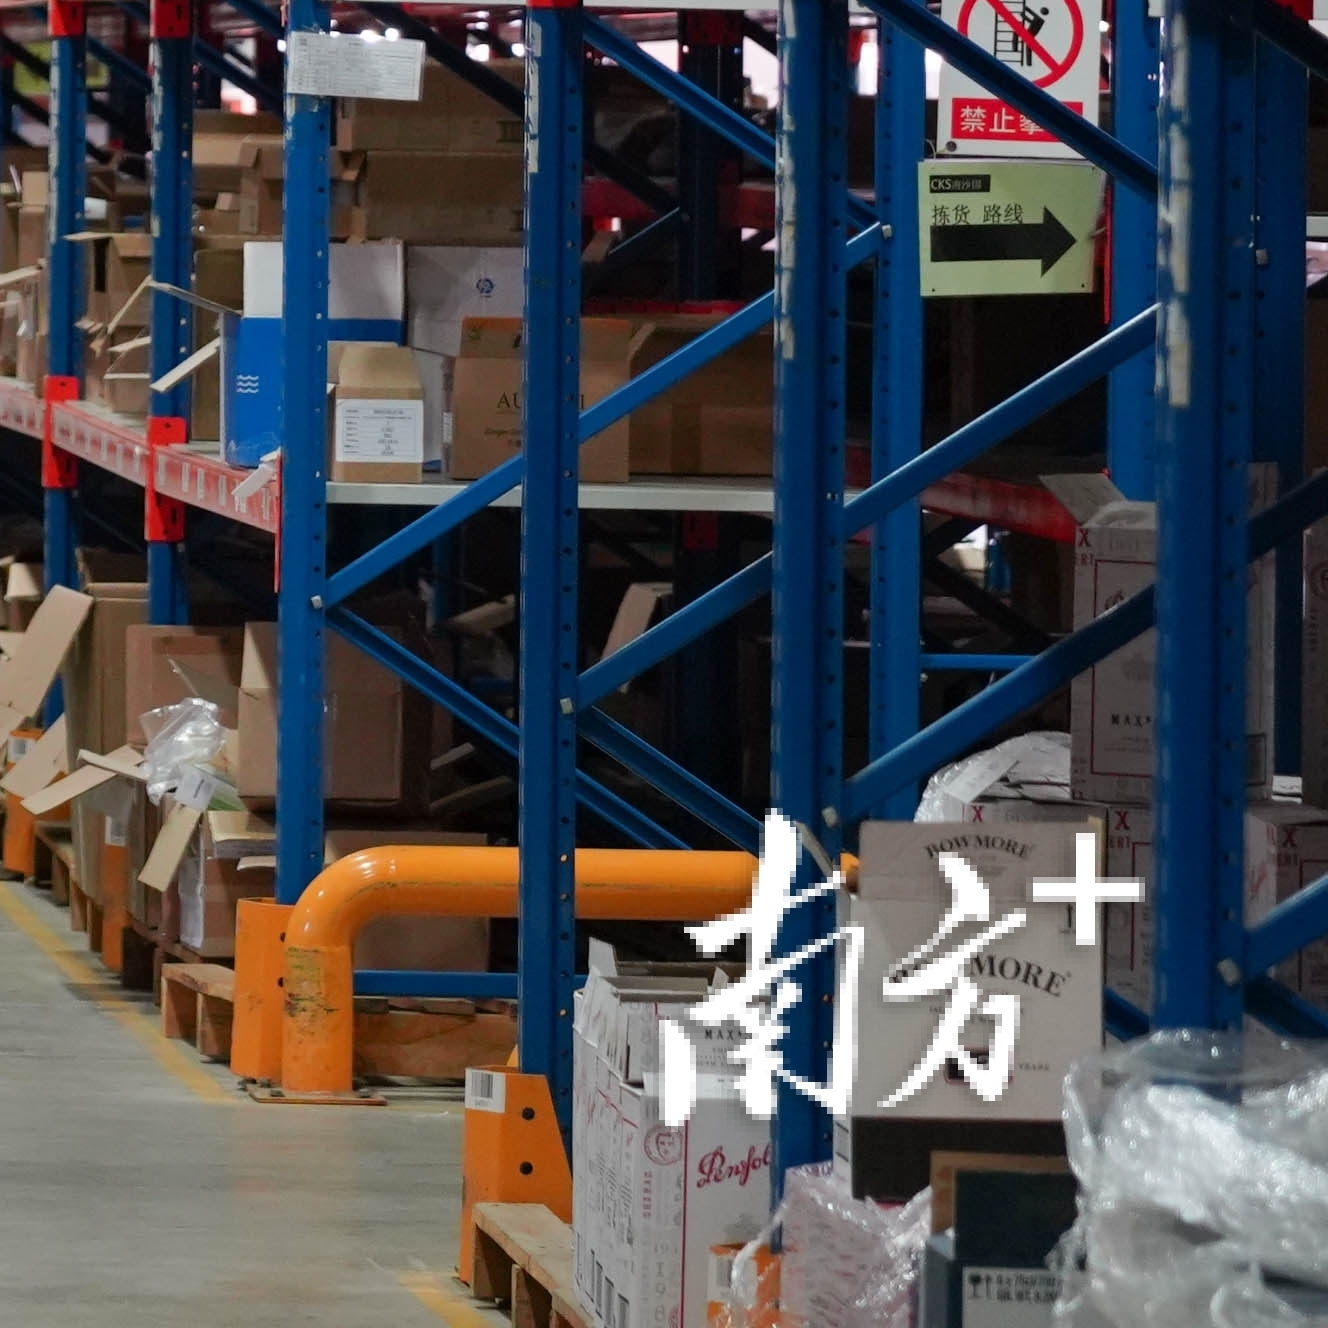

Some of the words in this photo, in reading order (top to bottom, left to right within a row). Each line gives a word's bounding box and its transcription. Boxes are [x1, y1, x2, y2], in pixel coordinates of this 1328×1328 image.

[960, 105, 1045, 135] 禁止攀
[932, 204, 971, 225] 拣货
[982, 203, 1024, 224] 路线
[925, 834, 1032, 859] BOWMORE
[696, 1142, 771, 1189] Penfol
